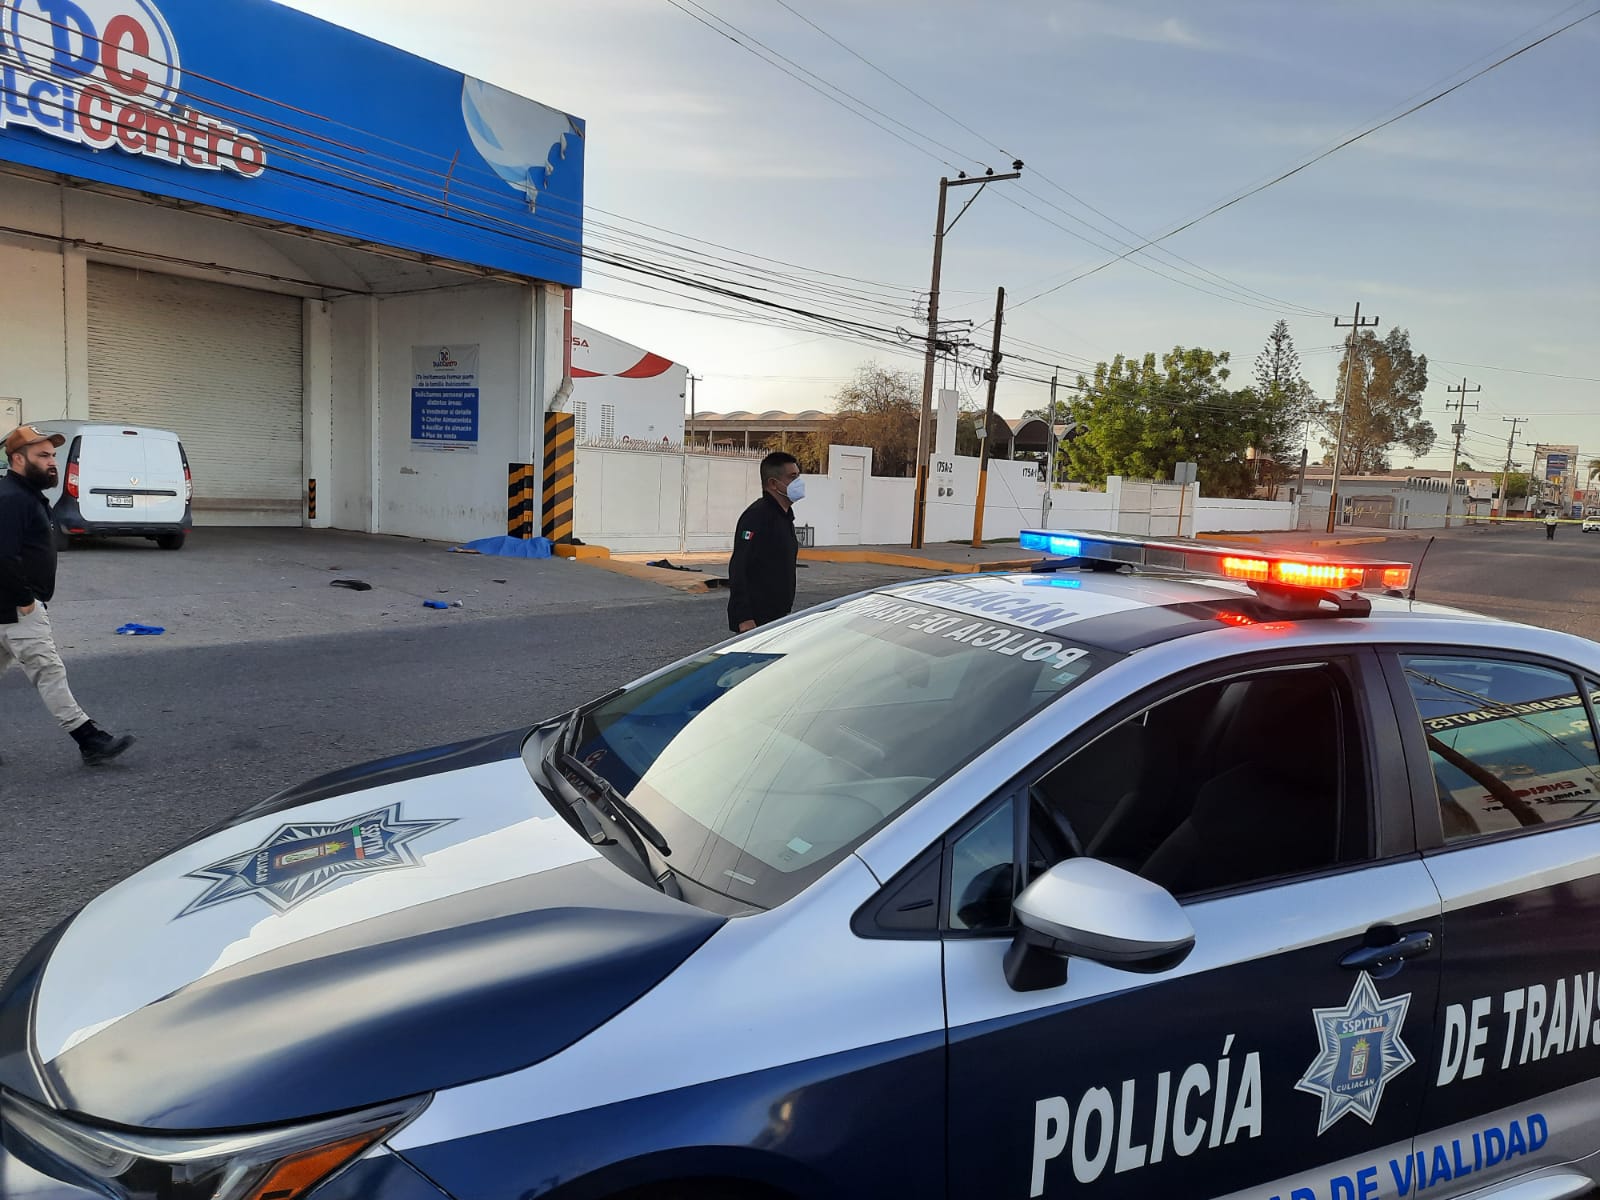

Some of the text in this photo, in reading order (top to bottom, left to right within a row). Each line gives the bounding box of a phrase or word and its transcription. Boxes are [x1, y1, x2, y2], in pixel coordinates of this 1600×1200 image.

[38, 0, 149, 97] DC
[1342, 1015, 1384, 1034] SSPYTM
[1030, 1033, 1262, 1198] POLICÍA
[1436, 996, 1491, 1087] DE
[1330, 1112, 1549, 1200] DE VIALIDAD
